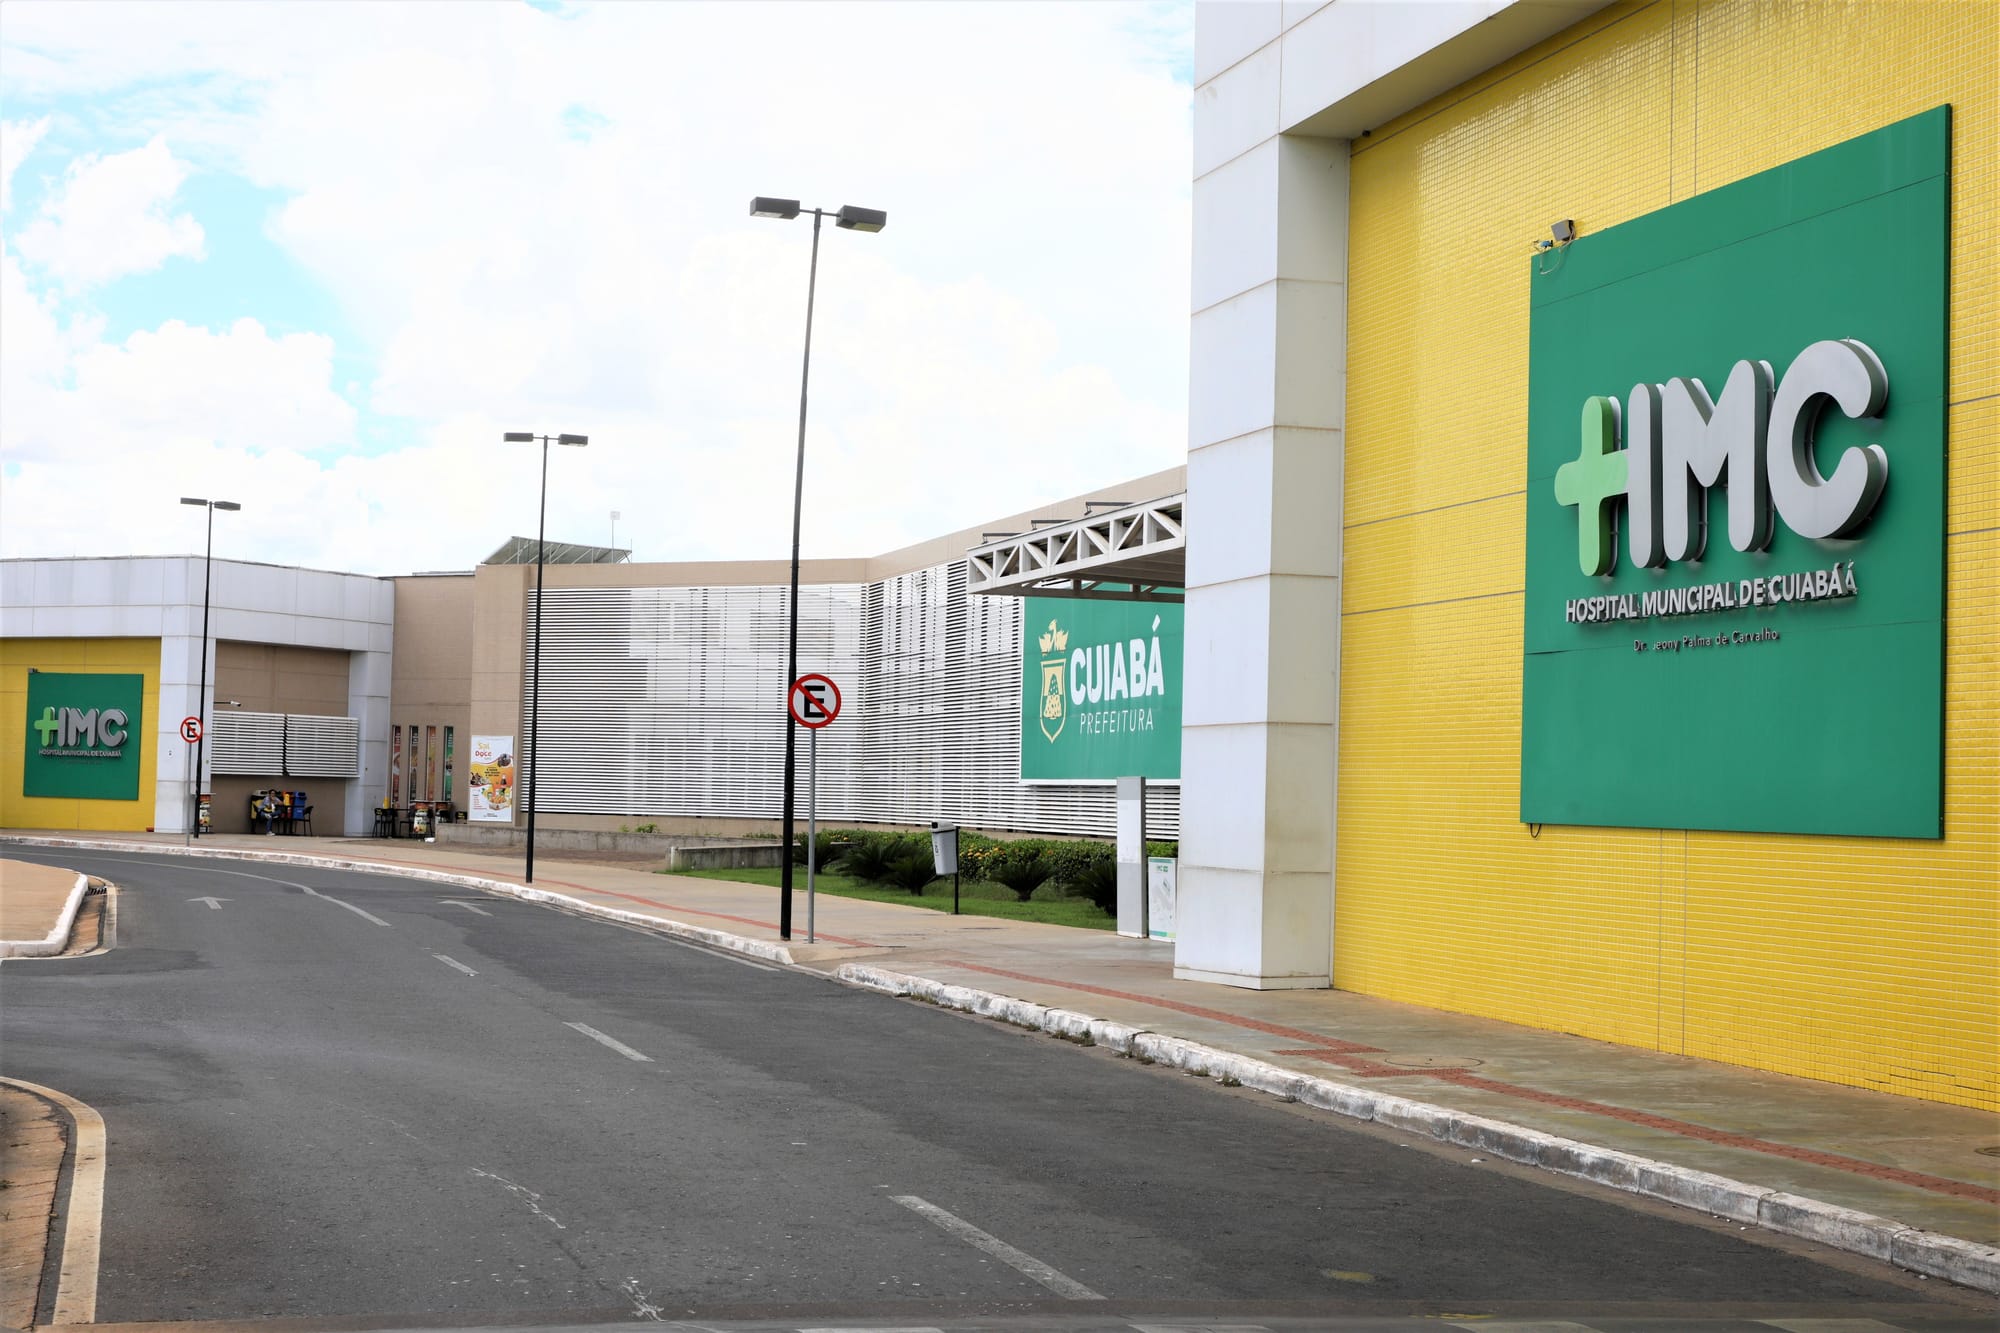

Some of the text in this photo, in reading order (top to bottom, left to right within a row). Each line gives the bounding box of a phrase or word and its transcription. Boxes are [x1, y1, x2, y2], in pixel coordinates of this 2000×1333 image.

[1565, 562, 1847, 623] HOSPITAL MUNICIPAL DE CUIABÁ
[1633, 639, 1648, 652] Dr.
[1682, 635, 1712, 649] Palma
[1715, 632, 1728, 646] de
[1731, 627, 1778, 644] Carvalho
[1070, 614, 1164, 706] CUIABÁ
[804, 685, 825, 718] E
[1080, 708, 1154, 735] PREFEITURA
